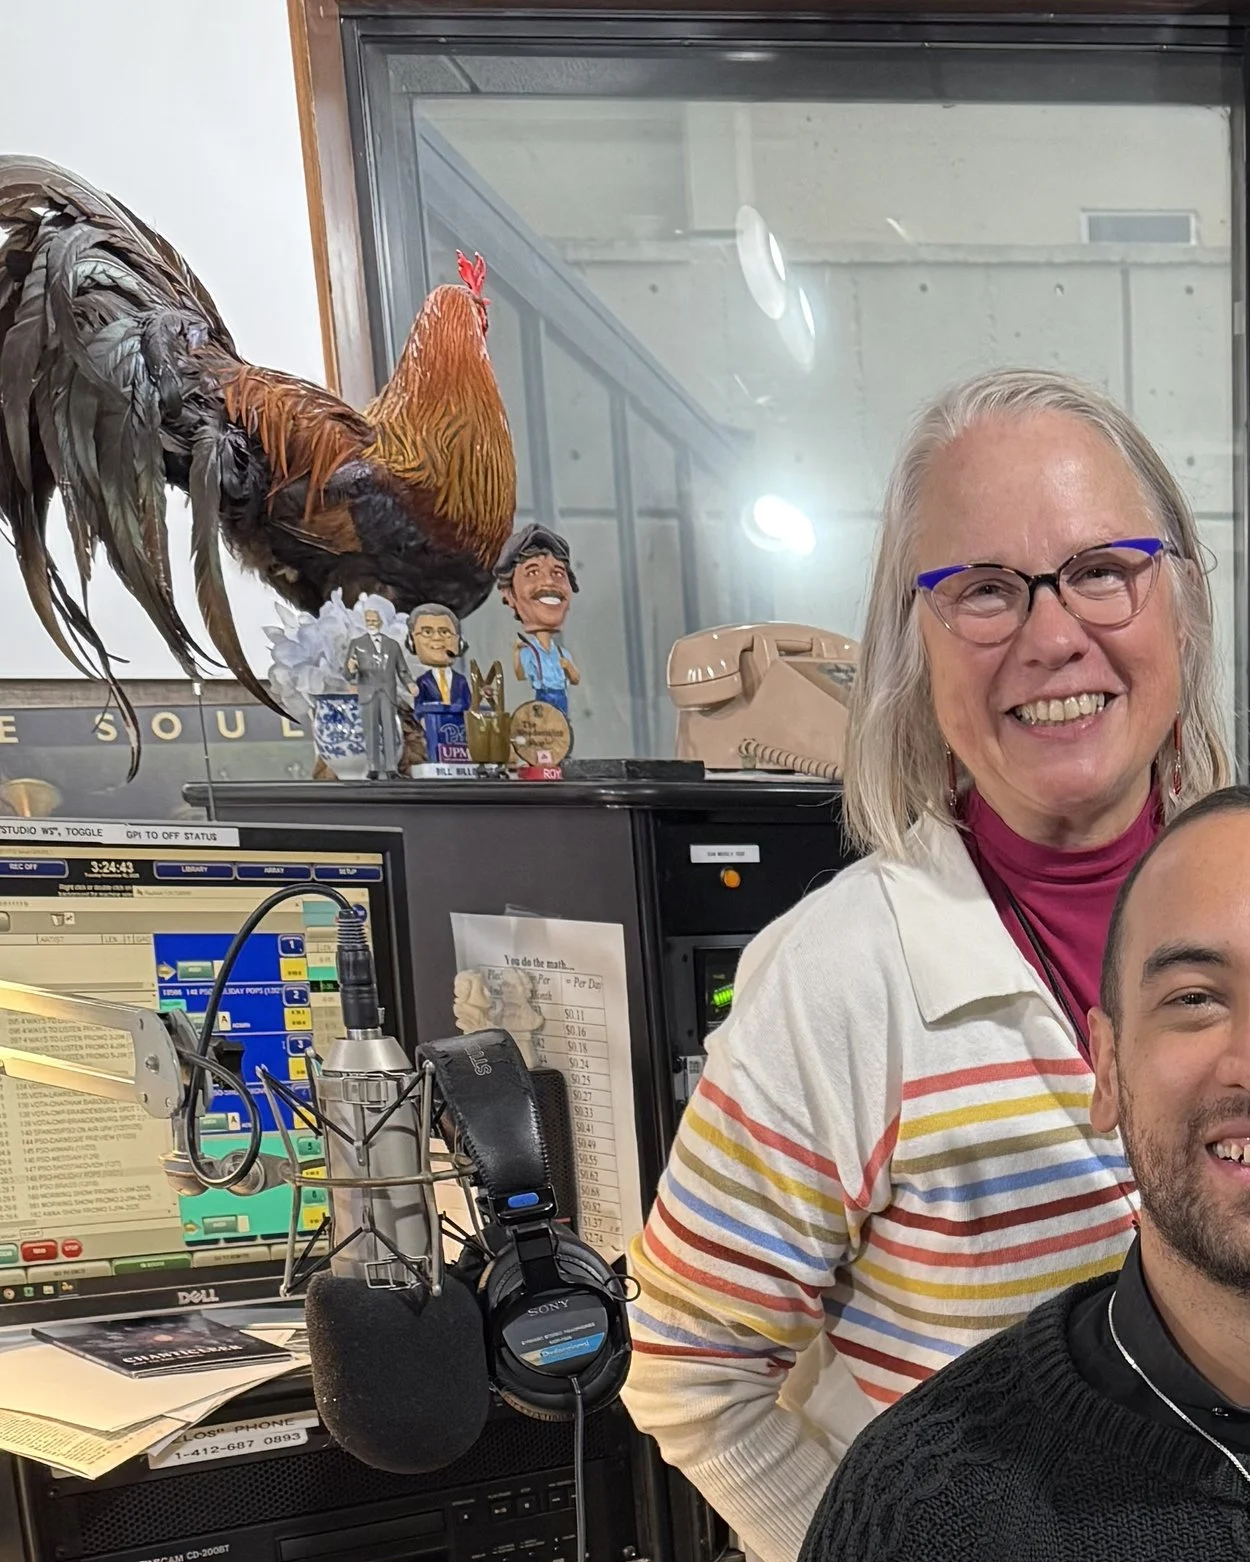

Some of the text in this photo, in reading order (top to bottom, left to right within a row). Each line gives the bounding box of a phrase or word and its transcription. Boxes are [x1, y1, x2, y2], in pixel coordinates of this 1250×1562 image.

[443, 746, 470, 758] UPM
[543, 768, 562, 780] ROY
[66, 828, 103, 837] TOGGLE
[146, 831, 158, 840] TO
[162, 831, 180, 841] OFF
[184, 832, 218, 842] STATUS
[91, 861, 135, 873] 3:24:43
[181, 866, 208, 874] LIBRARY
[505, 954, 520, 966] You
[521, 956, 532, 967] do
[533, 957, 545, 968] the
[573, 976, 588, 989] Per
[564, 1009, 585, 1021] $0.11
[566, 1025, 587, 1037] $0.16
[569, 1057, 589, 1069] $0.24
[571, 1073, 591, 1085] $0.25
[573, 1090, 592, 1102] $0.27
[574, 1106, 594, 1118] $0.33
[576, 1122, 594, 1135] $0.41
[577, 1138, 597, 1150] $0.49
[579, 1153, 598, 1166] $0.55
[580, 1169, 599, 1182] $0.62
[583, 1216, 603, 1228] $1.37
[585, 1231, 604, 1244] $2.74
[177, 1288, 220, 1305] DELL
[527, 1299, 569, 1317] SONY
[122, 1344, 244, 1365] CHANTICLEER
[234, 1417, 295, 1434] PHONE
[175, 1432, 302, 1461] 1-412-687 0893
[186, 1543, 230, 1561] CD-200BT
